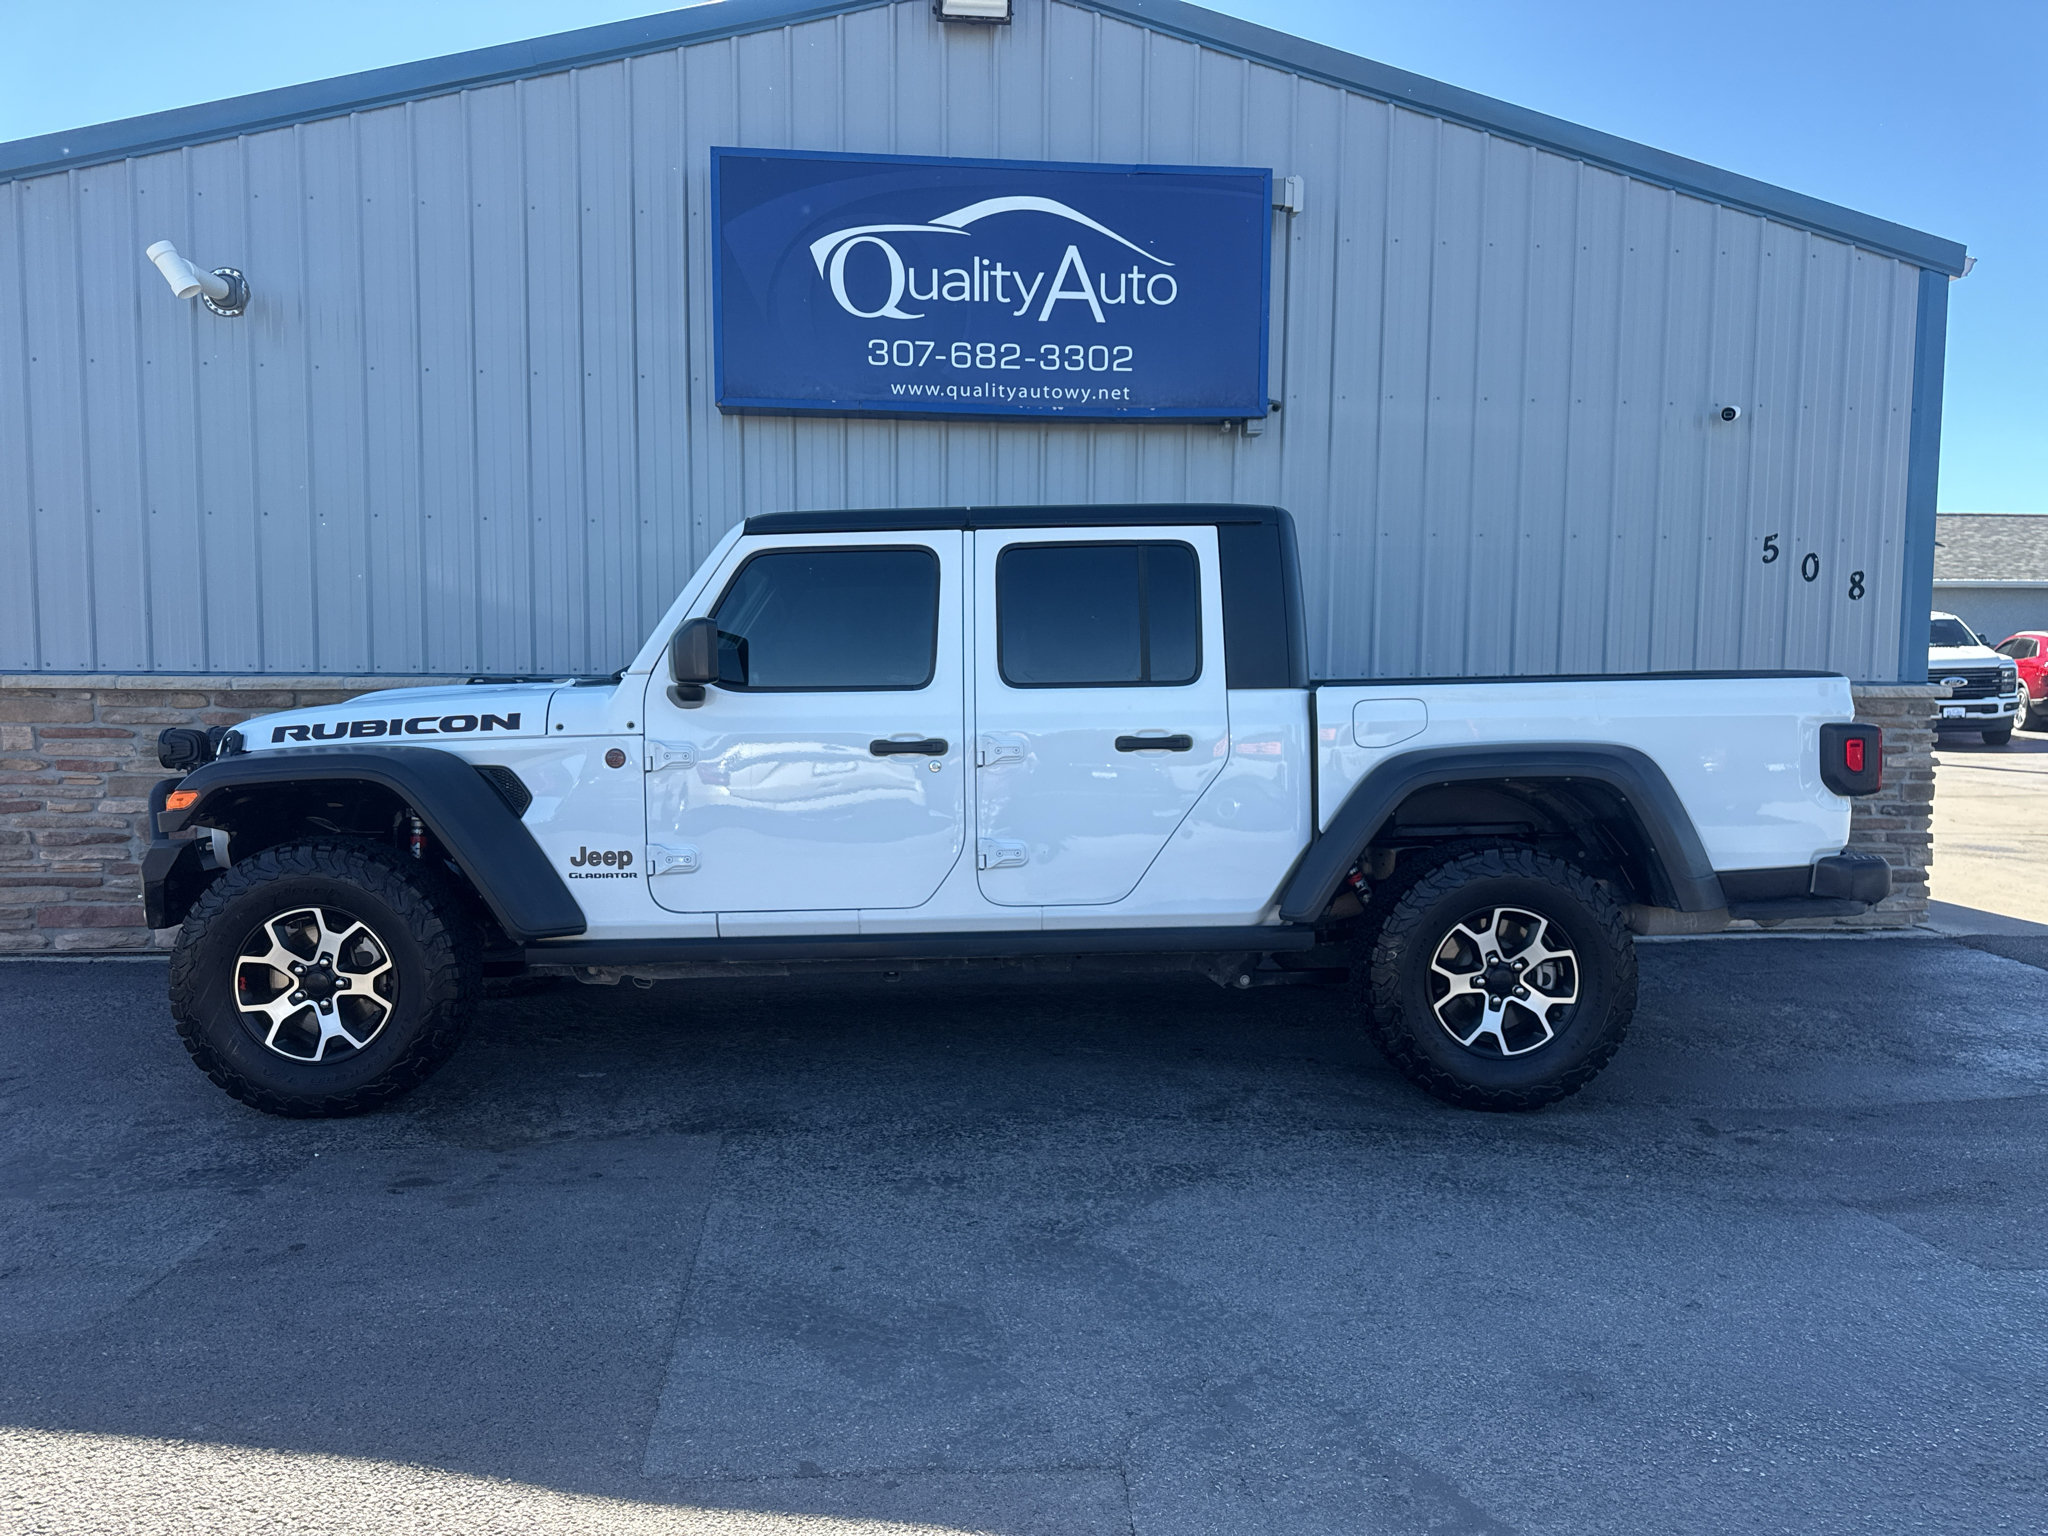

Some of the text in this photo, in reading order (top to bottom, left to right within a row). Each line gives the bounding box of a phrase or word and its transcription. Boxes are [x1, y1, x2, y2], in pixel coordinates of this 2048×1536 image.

[867, 338, 1134, 372] 307-682-3302
[890, 382, 1131, 403] www.qualityautowy.net
[271, 712, 521, 743] RUBICON
[570, 846, 633, 870] Jeep
